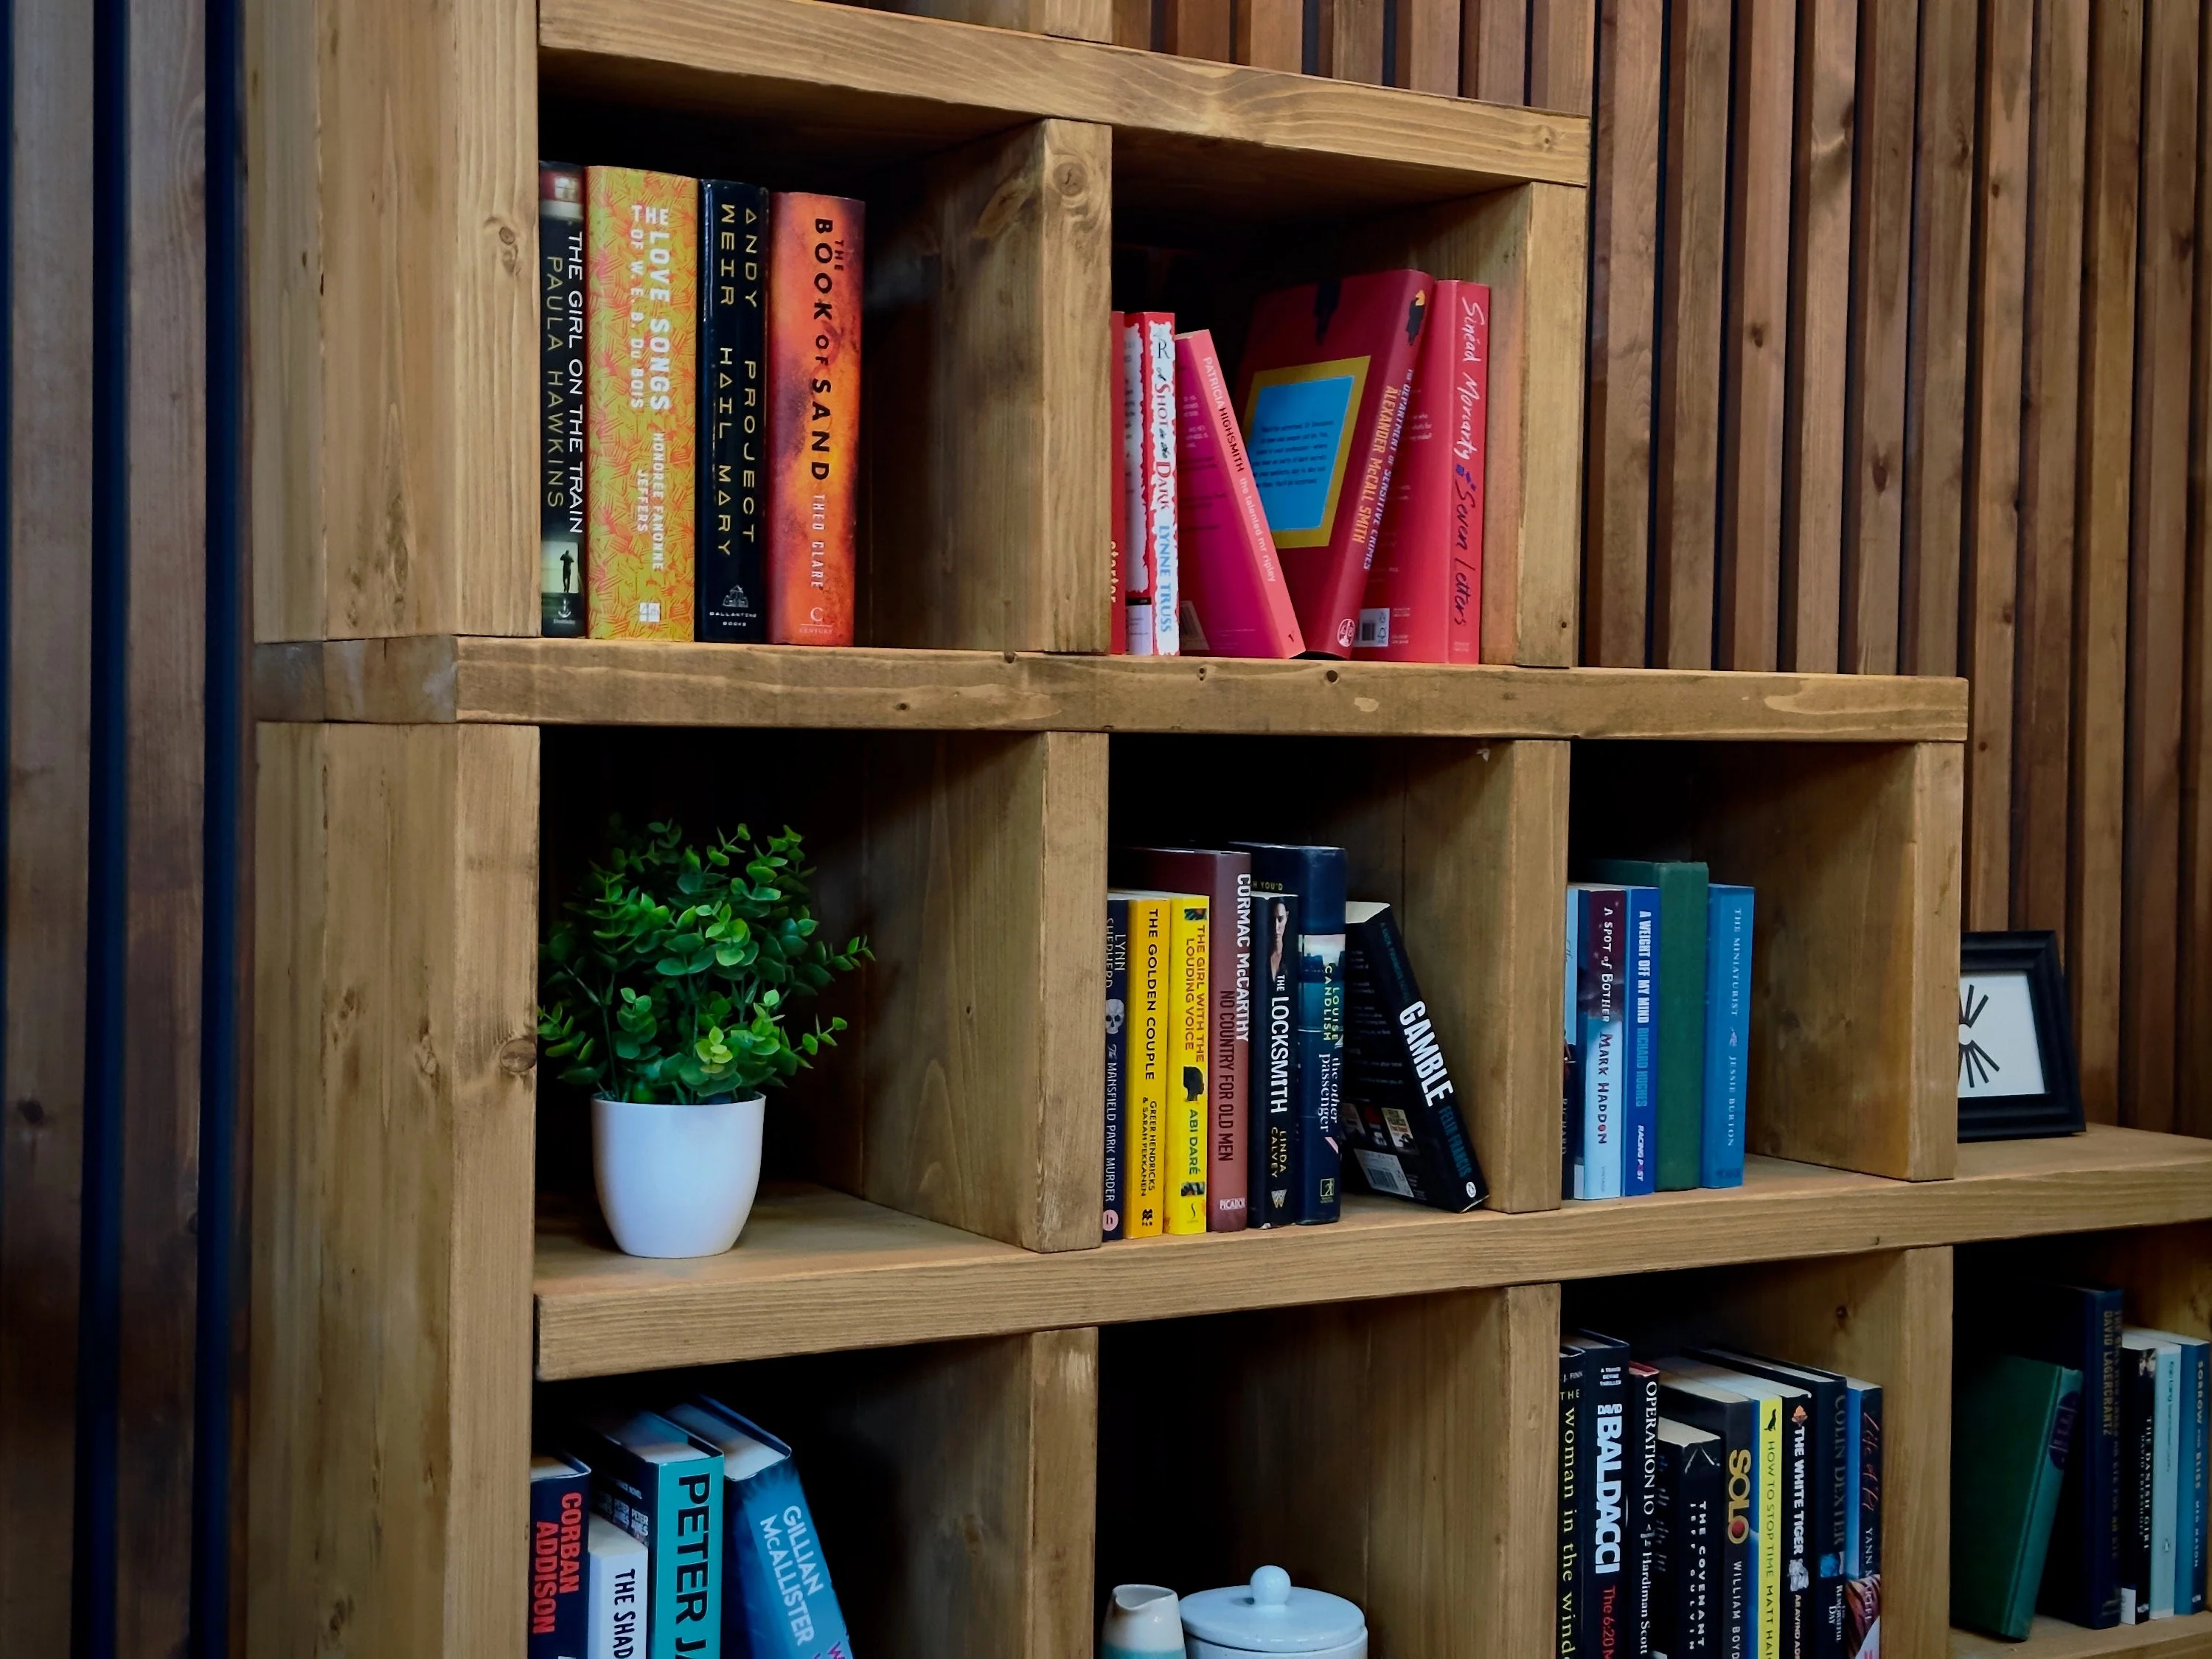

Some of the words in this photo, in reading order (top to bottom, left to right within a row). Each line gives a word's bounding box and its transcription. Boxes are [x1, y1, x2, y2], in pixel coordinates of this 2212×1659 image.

[631, 206, 669, 226] THE
[631, 229, 644, 249] OF
[568, 232, 582, 280] THE
[650, 231, 670, 302] LOVE
[720, 204, 736, 306] WEIR
[745, 207, 757, 308] ANDY
[813, 218, 833, 321] BOOK
[834, 240, 844, 271] THE
[547, 256, 563, 351] PAULA
[568, 290, 582, 349] GIRL
[815, 334, 830, 366] OF
[1461, 296, 1486, 363] Sinéad
[568, 359, 582, 394] ON
[630, 368, 644, 409] BOIS
[650, 319, 670, 412] SONGS
[718, 347, 734, 439] HAIL
[1155, 383, 1171, 427] SHOT
[1390, 384, 1411, 445] DEPARTMENT
[1453, 371, 1481, 460] Moriarty
[548, 370, 564, 508] HAWKINS
[568, 405, 582, 453] THE
[811, 378, 832, 480] SAND
[1371, 385, 1398, 456] ALEXANDER
[742, 360, 757, 543] PROJECT
[568, 462, 582, 533] TRAIN
[637, 470, 649, 532] JEFFERS
[1155, 462, 1171, 510] DARK
[1363, 457, 1382, 504] McCALL
[1374, 469, 1392, 527] SENSITIVE
[717, 465, 732, 556] MARY
[813, 493, 825, 531] THEO
[1239, 477, 1249, 495] the
[1245, 495, 1263, 540] talented
[1257, 538, 1267, 554] mr
[1262, 554, 1277, 582] ripley
[1352, 505, 1372, 544] SMITH
[1455, 479, 1476, 552] Seven
[652, 505, 664, 571] FANONNE
[1159, 525, 1171, 577] LYNNE
[1363, 529, 1380, 572] CRIMES
[811, 540, 824, 588] CLARE
[1159, 582, 1172, 633] TRUSS
[1454, 557, 1476, 626] Letters
[1148, 908, 1158, 938] THE
[1236, 873, 1251, 948] CORMAC
[1603, 906, 1613, 917] A
[1638, 910, 1652, 919] A
[1733, 908, 1742, 933] THE
[1114, 933, 1127, 971] LYNN
[1197, 925, 1206, 953] THE
[1601, 921, 1614, 953] SPOT
[1638, 920, 1652, 958] WEIGHT
[1147, 943, 1158, 1011] GOLDEN
[1186, 938, 1194, 1004] LOUDING
[1196, 956, 1206, 990] GIRL
[1276, 974, 1286, 992] THE
[1600, 955, 1613, 970] of
[1638, 959, 1651, 977] OFF
[1731, 937, 1742, 1018] MINIATURIST
[1220, 990, 1235, 1009] NO
[1236, 952, 1250, 1043] McCARTHY
[1323, 964, 1333, 1041] CANDLISH
[1601, 973, 1614, 1023] BOTHER
[1636, 997, 1650, 1023] MIND
[1637, 979, 1651, 995] MY
[1185, 1006, 1194, 1051] VOICE
[1196, 992, 1205, 1031] WITH
[1332, 987, 1340, 1041] LOUISE
[1145, 1017, 1156, 1080] COUPLE
[1196, 1034, 1205, 1062] THE
[1219, 1012, 1235, 1071] COUNTRY
[1270, 996, 1290, 1114] LOCKSMITH
[1399, 1001, 1454, 1107] GAMBLE
[1598, 1032, 1613, 1076] MARK
[1636, 1027, 1649, 1069] RICHARD
[1106, 1062, 1118, 1121] MANSFIELD
[1218, 1074, 1234, 1100] FOR
[1331, 1057, 1340, 1079] the
[1635, 1070, 1649, 1107] HUGHES
[1728, 1055, 1737, 1093] JESSIE
[1150, 1100, 1158, 1133] GREER
[1218, 1102, 1234, 1130] OLD
[1317, 1053, 1332, 1133] passenger
[1330, 1083, 1340, 1124] other
[1596, 1082, 1610, 1144] HADDON
[1105, 1124, 1116, 1154] PARK
[1189, 1109, 1199, 1133] ABI
[1637, 1124, 1645, 1158] RACING
[1728, 1097, 1736, 1147] BURTON
[1141, 1143, 1149, 1197] PEKKANEN
[1147, 1134, 1157, 1191] HENDRICKS
[1189, 1138, 1201, 1175] DARÉ
[1218, 1133, 1234, 1162] MEN
[1270, 1127, 1279, 1178] CALVEY
[1278, 1130, 1287, 1172] LINDA
[1636, 1159, 1644, 1182] POST
[1105, 1158, 1116, 1202] MURDER
[2103, 1310, 2114, 1346] DAVID
[1559, 1389, 1580, 1401] THE
[1596, 1403, 1623, 1415] DAVID
[2102, 1351, 2113, 1436] LAGERCRANTZ
[2197, 1360, 2205, 1425] SORROW
[1644, 1381, 1658, 1489] OPERATION
[1794, 1426, 1806, 1457] THE
[1834, 1394, 1846, 1460] COLIN
[1767, 1441, 1775, 1477] HOW
[1595, 1415, 1623, 1574] BALDACCI
[1727, 1448, 1752, 1545] SOLO
[1767, 1480, 1775, 1500] TO
[1793, 1458, 1805, 1509] WHITE
[1833, 1466, 1846, 1546] DEXTER
[1562, 1509, 1578, 1534] in
[1698, 1500, 1707, 1535] THE
[1766, 1503, 1775, 1540] STOP
[1792, 1510, 1804, 1556] TIGER
[559, 1492, 582, 1595] CORBAN
[675, 1472, 711, 1624] PETER
[782, 1505, 824, 1596] GILLIAN
[1562, 1543, 1578, 1582] the
[1765, 1545, 1775, 1578] TIME
[1865, 1527, 1874, 1565] YANN
[532, 1520, 559, 1635] ADDISON
[614, 1568, 636, 1606] THE
[759, 1513, 815, 1646] McALLISTER
[1602, 1585, 1616, 1615] The
[1641, 1551, 1652, 1618] Hardiman
[1697, 1545, 1706, 1646] COVENANT
[1731, 1559, 1742, 1620] WILLIAM
[1560, 1590, 1576, 1659] wind
[1765, 1585, 1775, 1625] MATT
[1793, 1594, 1802, 1640] ARAVIND
[1601, 1617, 1615, 1647] 6:20
[1640, 1621, 1651, 1655] Scott
[1731, 1626, 1742, 1659] BOYD
